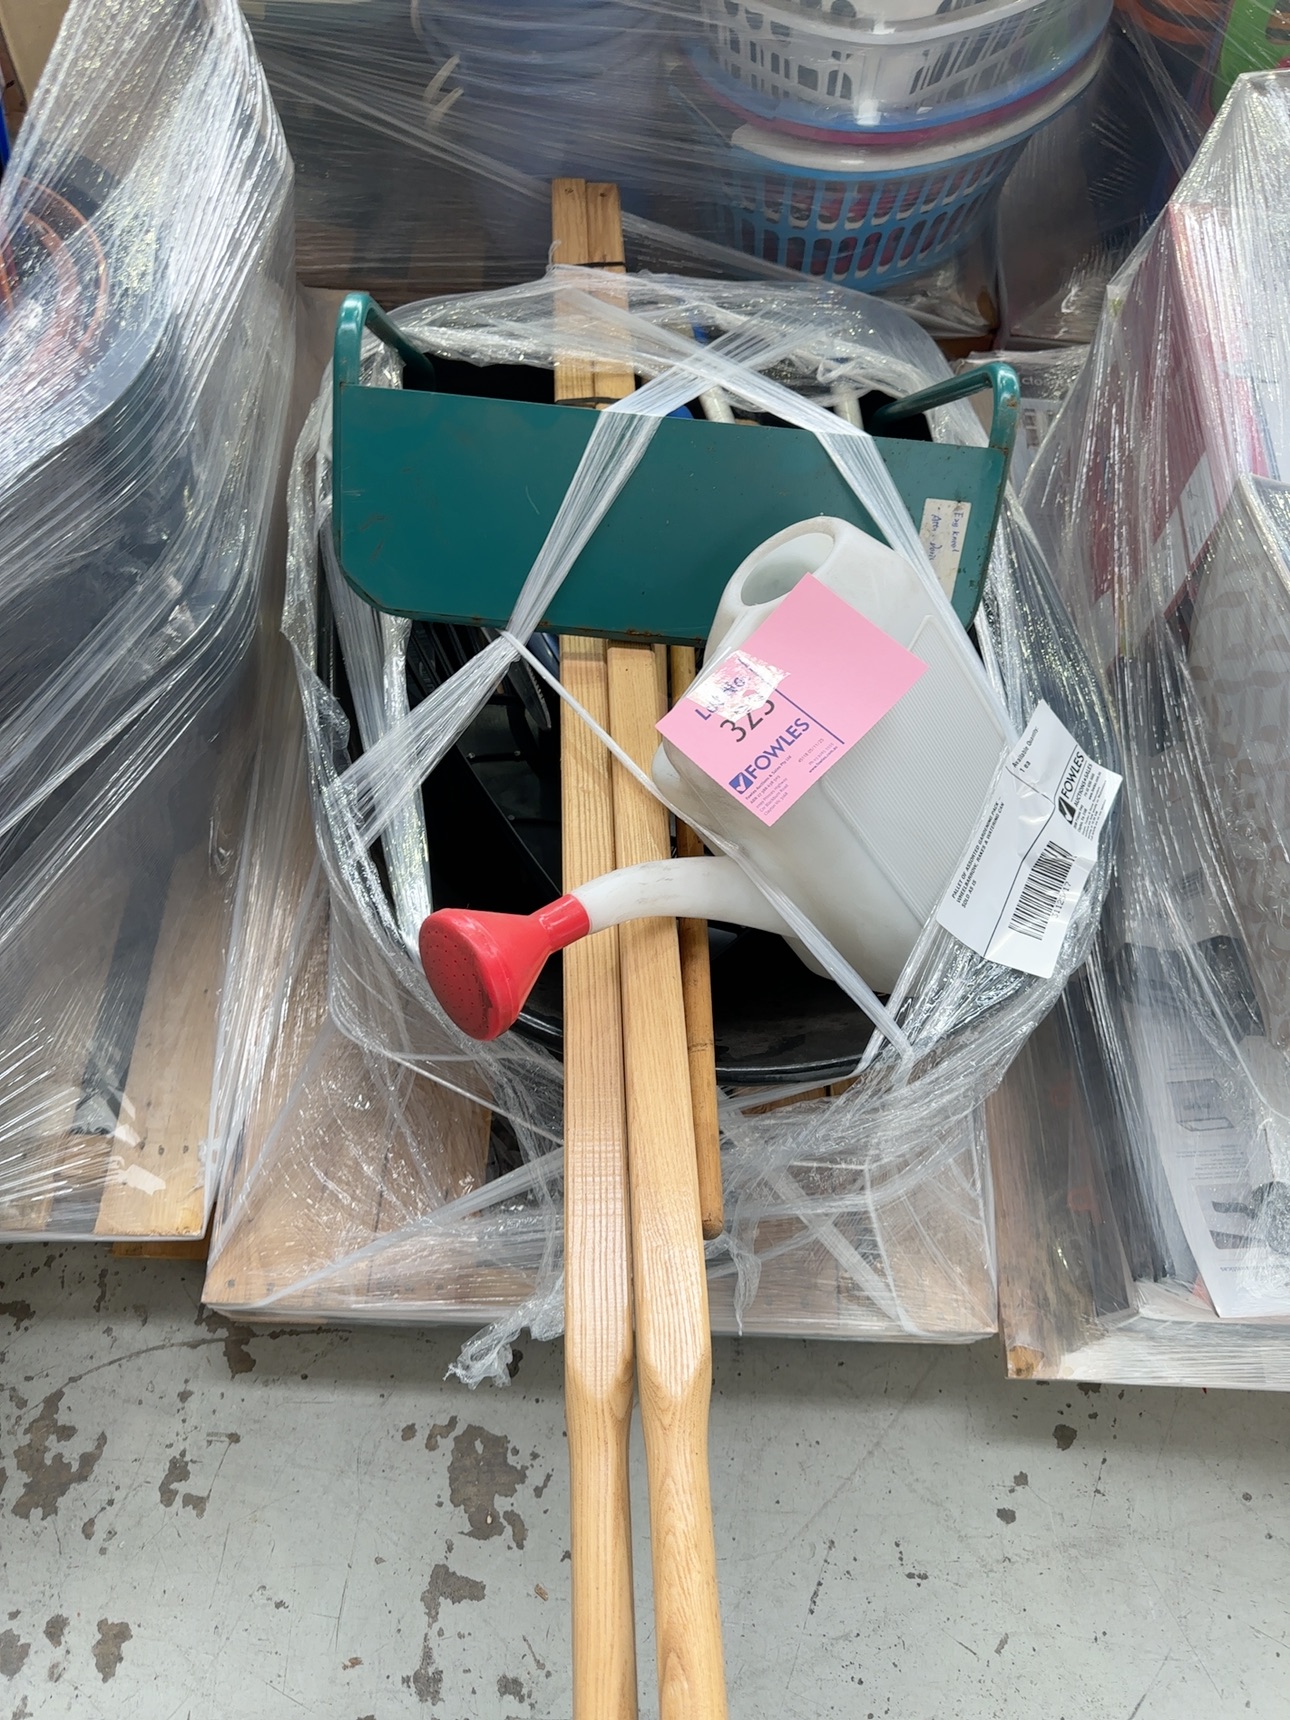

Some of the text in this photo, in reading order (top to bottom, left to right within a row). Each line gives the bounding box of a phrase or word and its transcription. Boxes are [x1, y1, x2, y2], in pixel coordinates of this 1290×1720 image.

[743, 715, 811, 780] FOWLES
[1010, 744, 1029, 768] Available
[1060, 750, 1085, 799] FOWLES
[950, 878, 963, 899] PALLET
[960, 870, 967, 880] OF
[964, 843, 980, 872] ASSORTED
[960, 892, 970, 909] SOLD
[966, 884, 974, 895] AS
